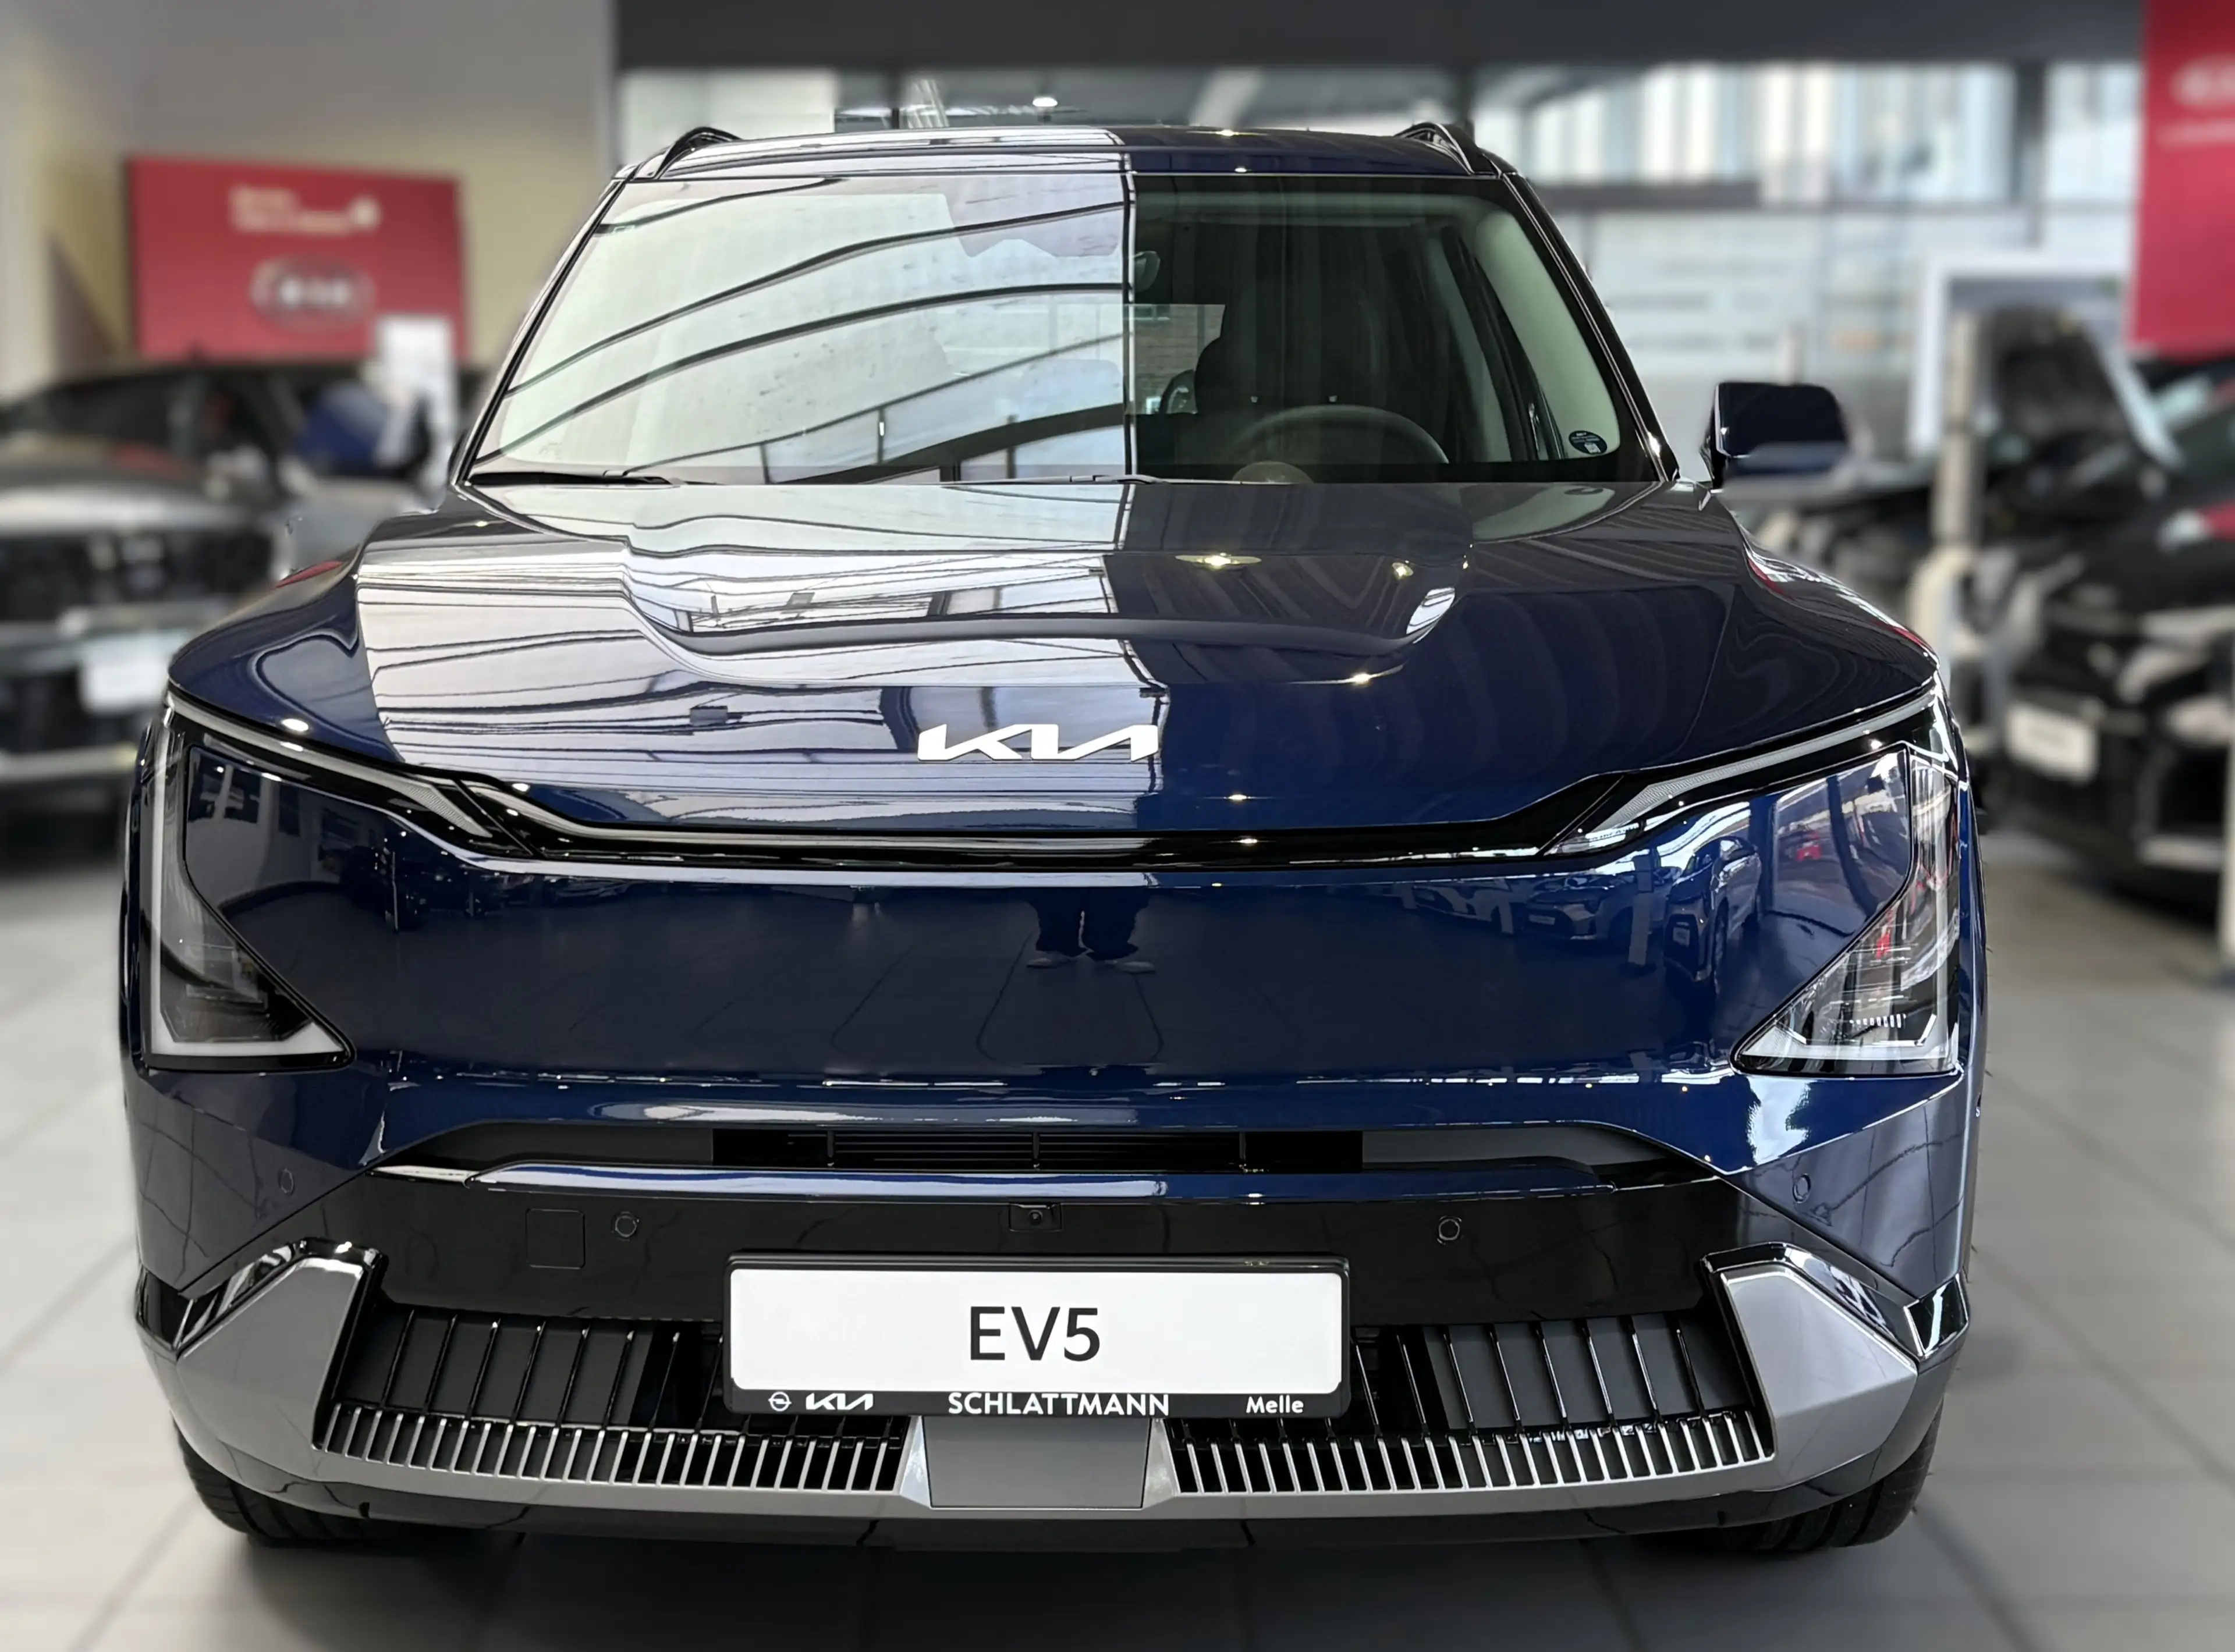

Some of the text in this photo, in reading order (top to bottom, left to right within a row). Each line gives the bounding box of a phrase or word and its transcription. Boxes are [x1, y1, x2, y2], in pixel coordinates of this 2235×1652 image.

[917, 724, 1158, 761] KIA
[970, 1306, 1100, 1362] EV5
[806, 1392, 1304, 1416] KIA SCHLATTMANN Melle
